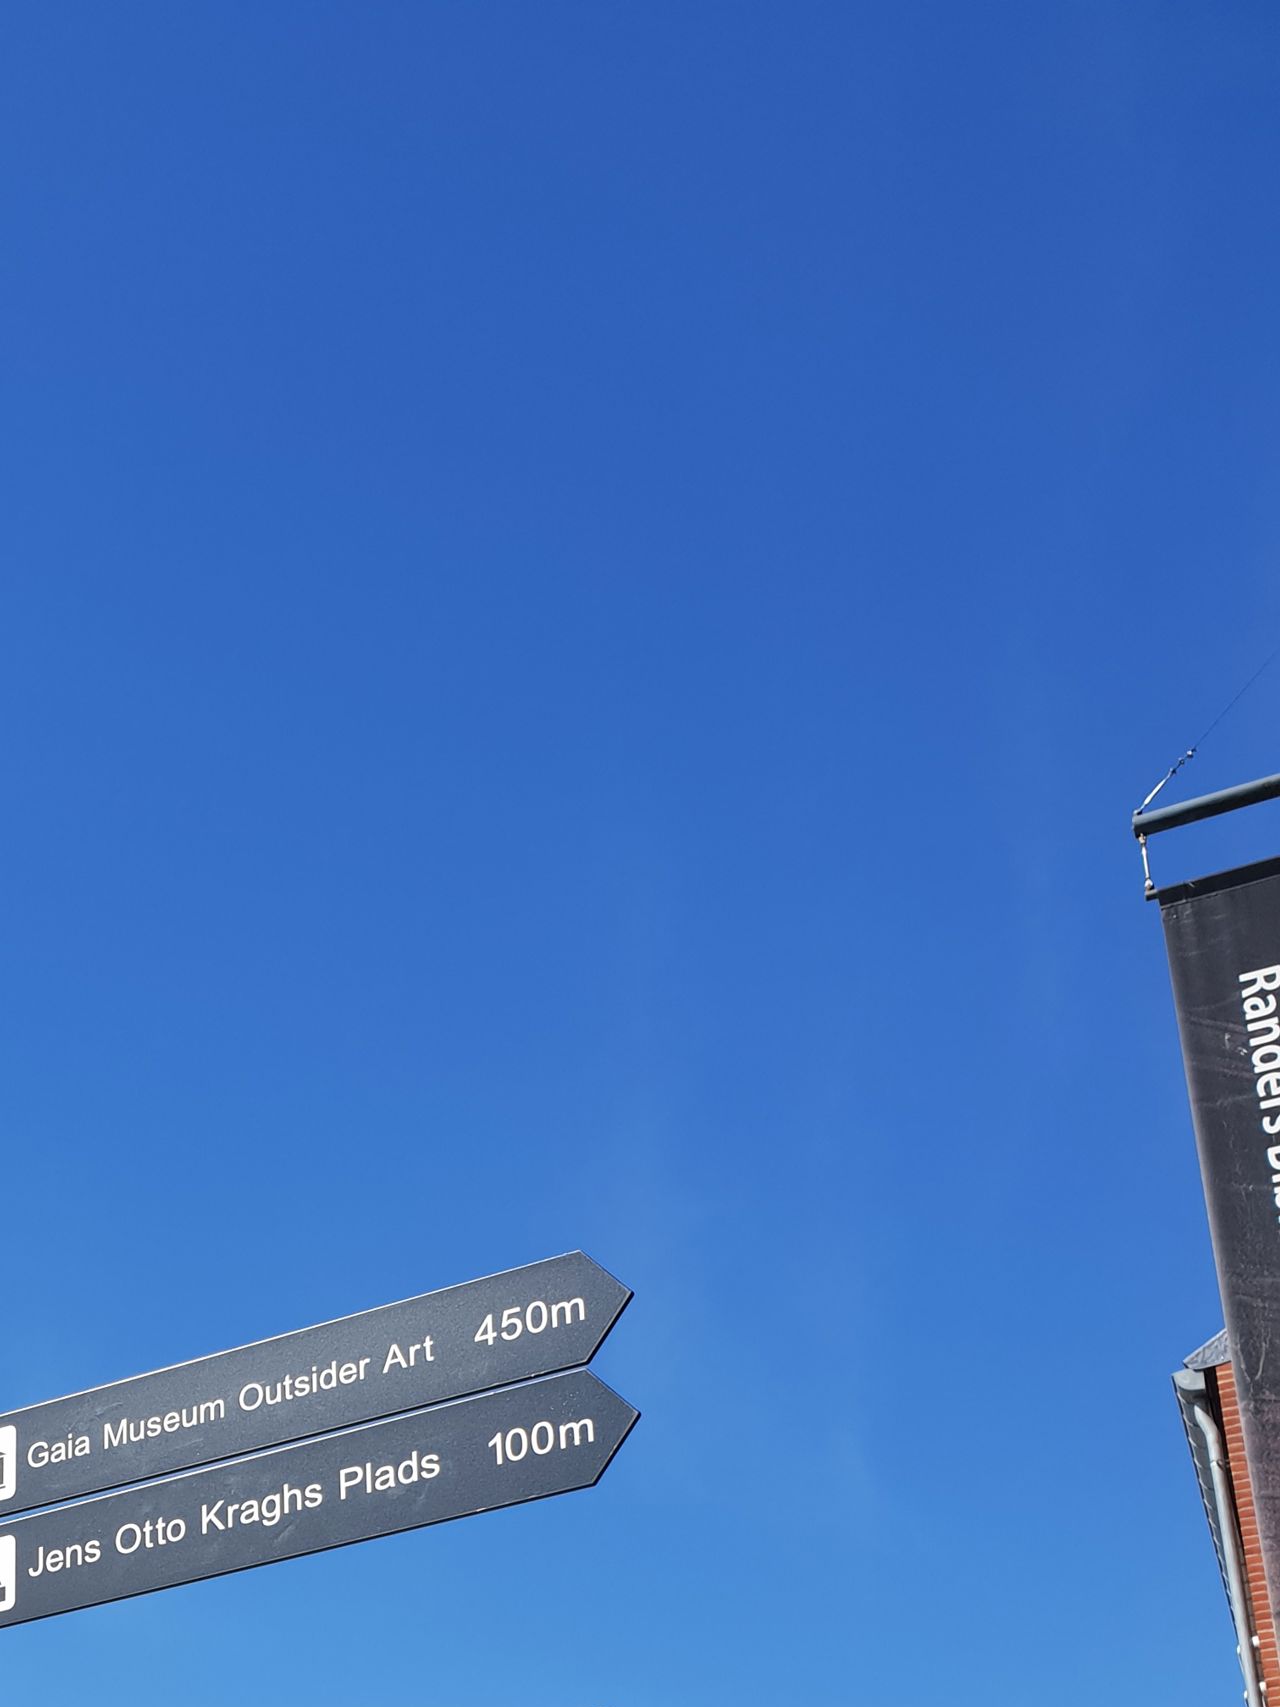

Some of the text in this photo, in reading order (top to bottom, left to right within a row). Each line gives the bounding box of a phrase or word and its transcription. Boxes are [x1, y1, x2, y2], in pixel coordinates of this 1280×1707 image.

[26, 1297, 587, 1468] Gaia Museum Outsider Art 450m
[27, 1417, 596, 1577] Jens Otto Kraghs Plads 100m
